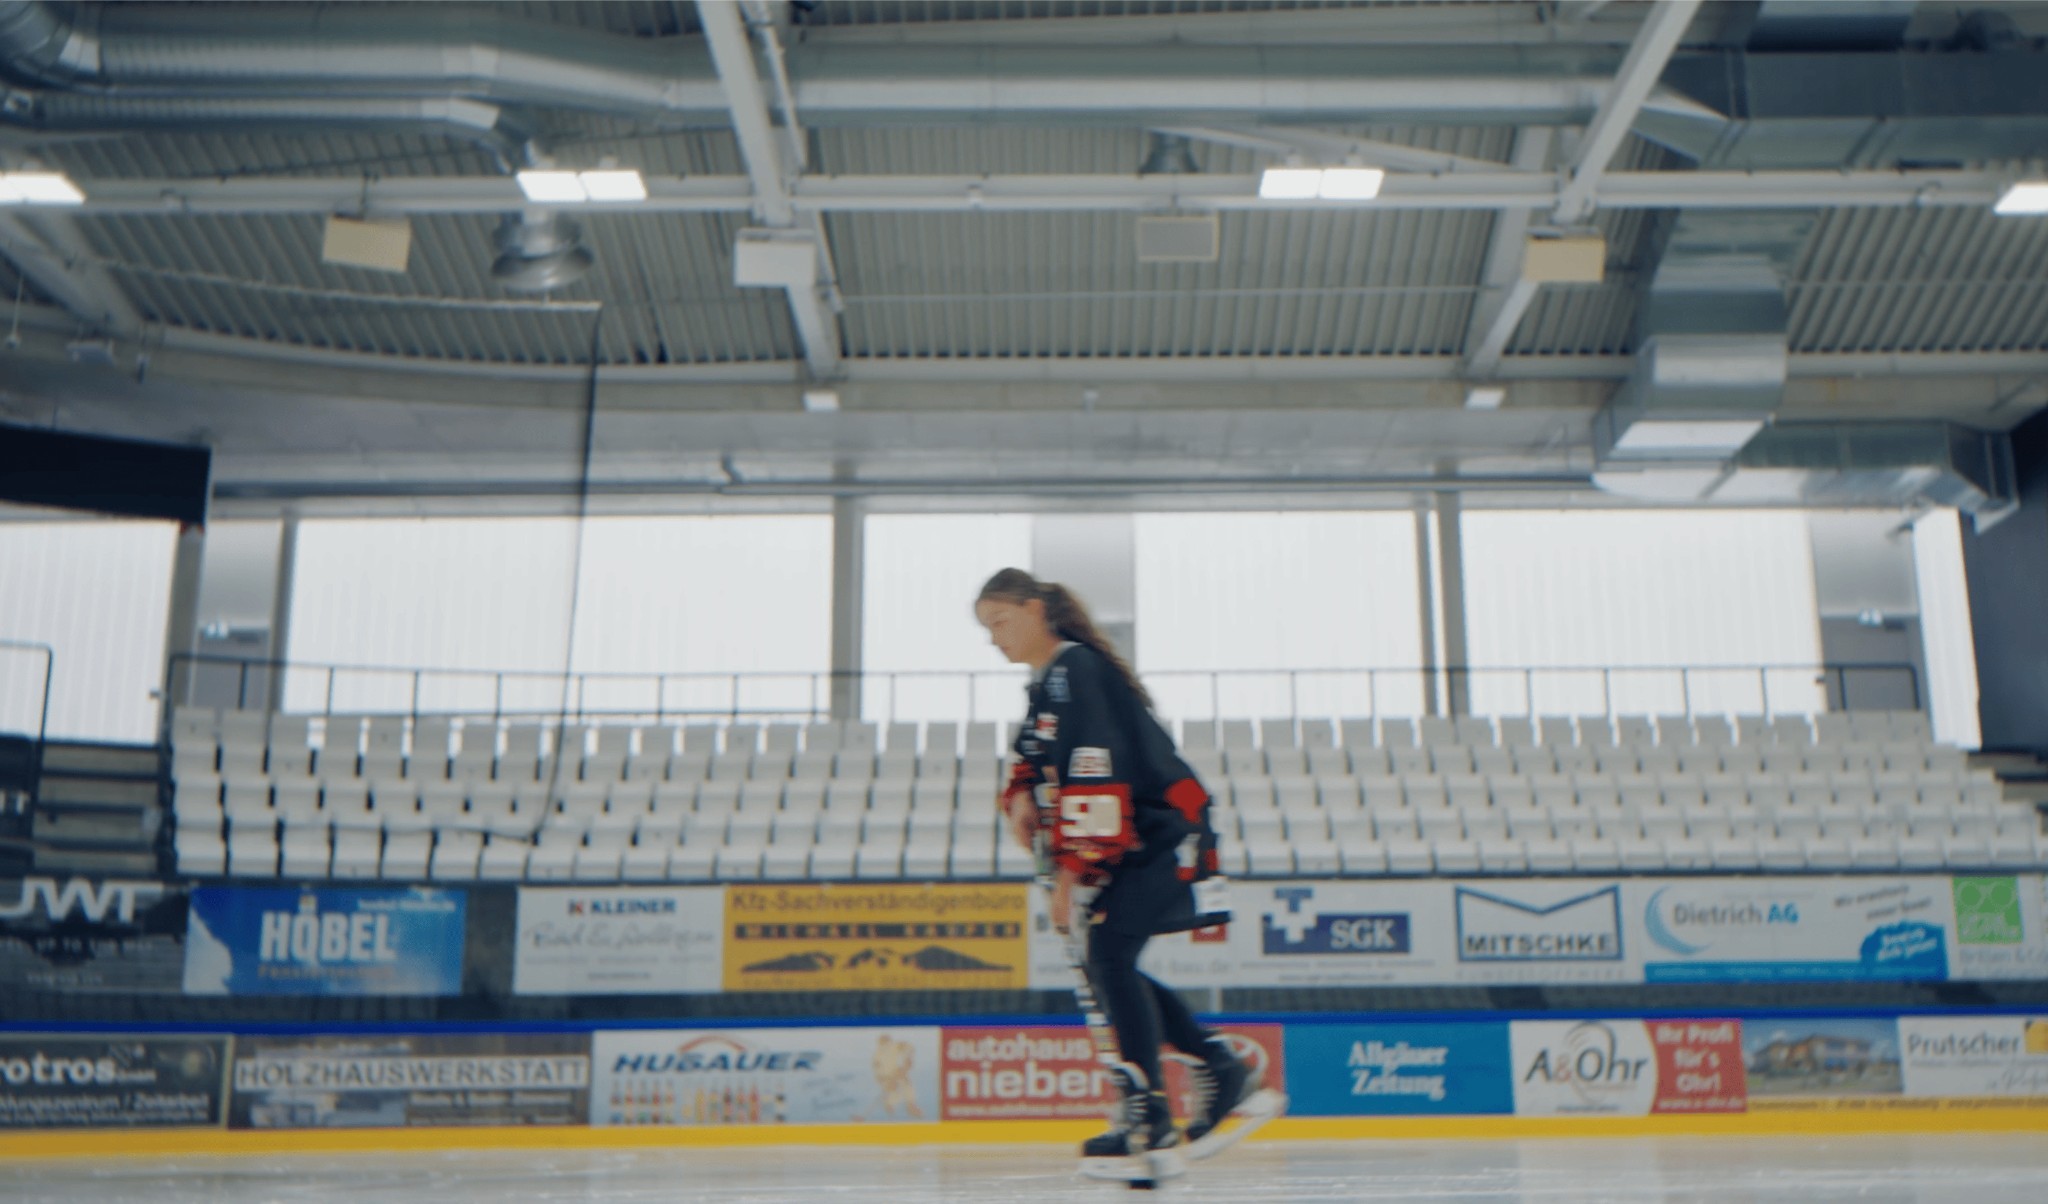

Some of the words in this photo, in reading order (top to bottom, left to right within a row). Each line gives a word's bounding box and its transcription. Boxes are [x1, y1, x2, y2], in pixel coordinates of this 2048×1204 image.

[590, 900, 676, 914] KLEINER
[1673, 903, 1763, 926] Dietrich
[1767, 902, 1800, 925] AG
[1329, 919, 1397, 949] SGK
[1465, 933, 1614, 953] MITSCHKE
[1656, 1026, 1683, 1043] Ihr
[1687, 1025, 1733, 1043] Profi
[1907, 1032, 2020, 1057] Prutscher
[947, 1034, 1092, 1061] autohaus
[1348, 1041, 1448, 1077] Allgäuer
[238, 1059, 582, 1084] HOLZHAUSWERKSTATT
[612, 1052, 824, 1073] HUGAUER
[1523, 1047, 1647, 1083] A&Ohr
[947, 1062, 1112, 1099] nieber
[1351, 1069, 1445, 1101] Zeitung
